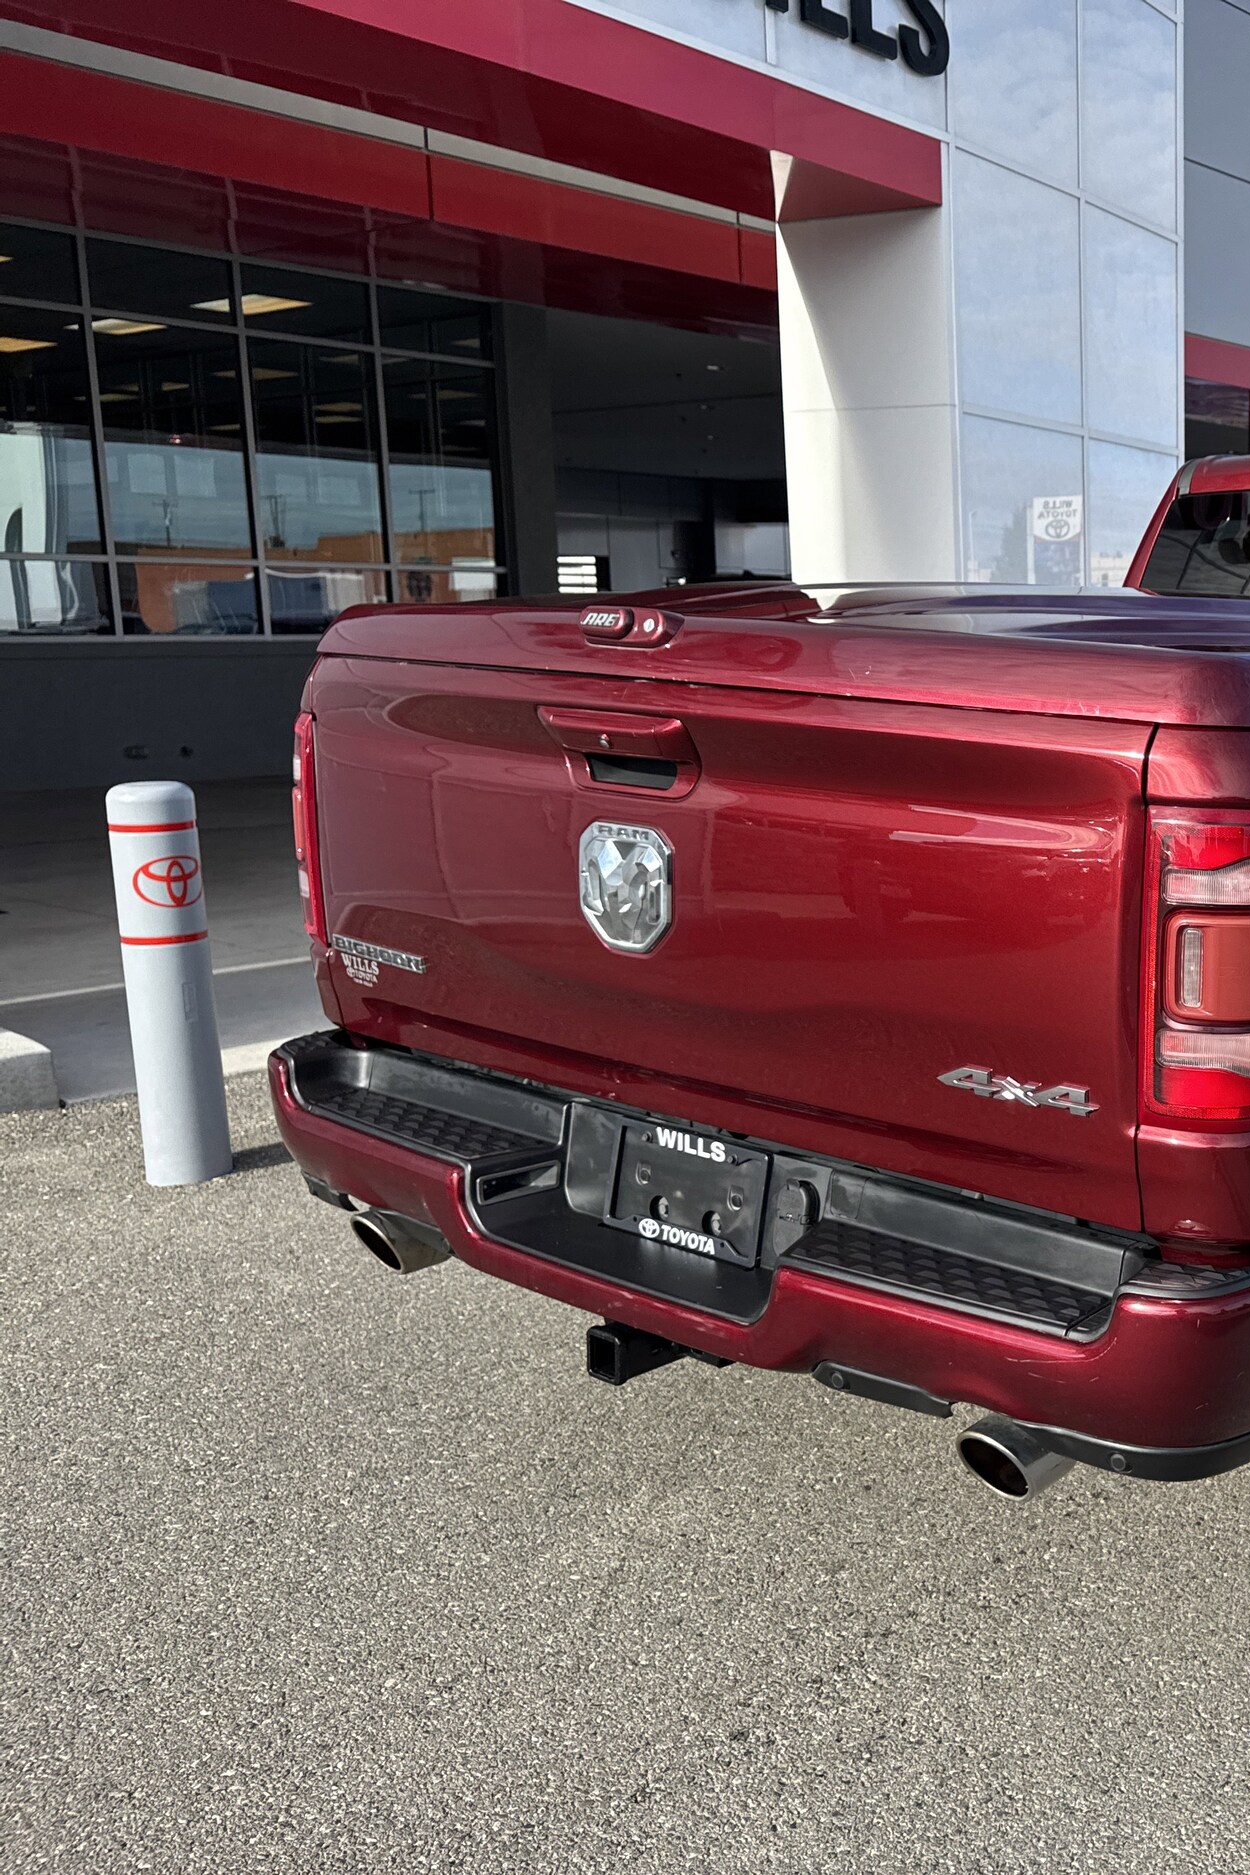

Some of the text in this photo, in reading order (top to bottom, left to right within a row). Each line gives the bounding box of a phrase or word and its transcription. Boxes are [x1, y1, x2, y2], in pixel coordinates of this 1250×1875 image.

[597, 824, 650, 841] RAM
[340, 952, 379, 976] WILLS
[655, 1126, 726, 1163] WILLS
[661, 1223, 716, 1255] TOYOTA
